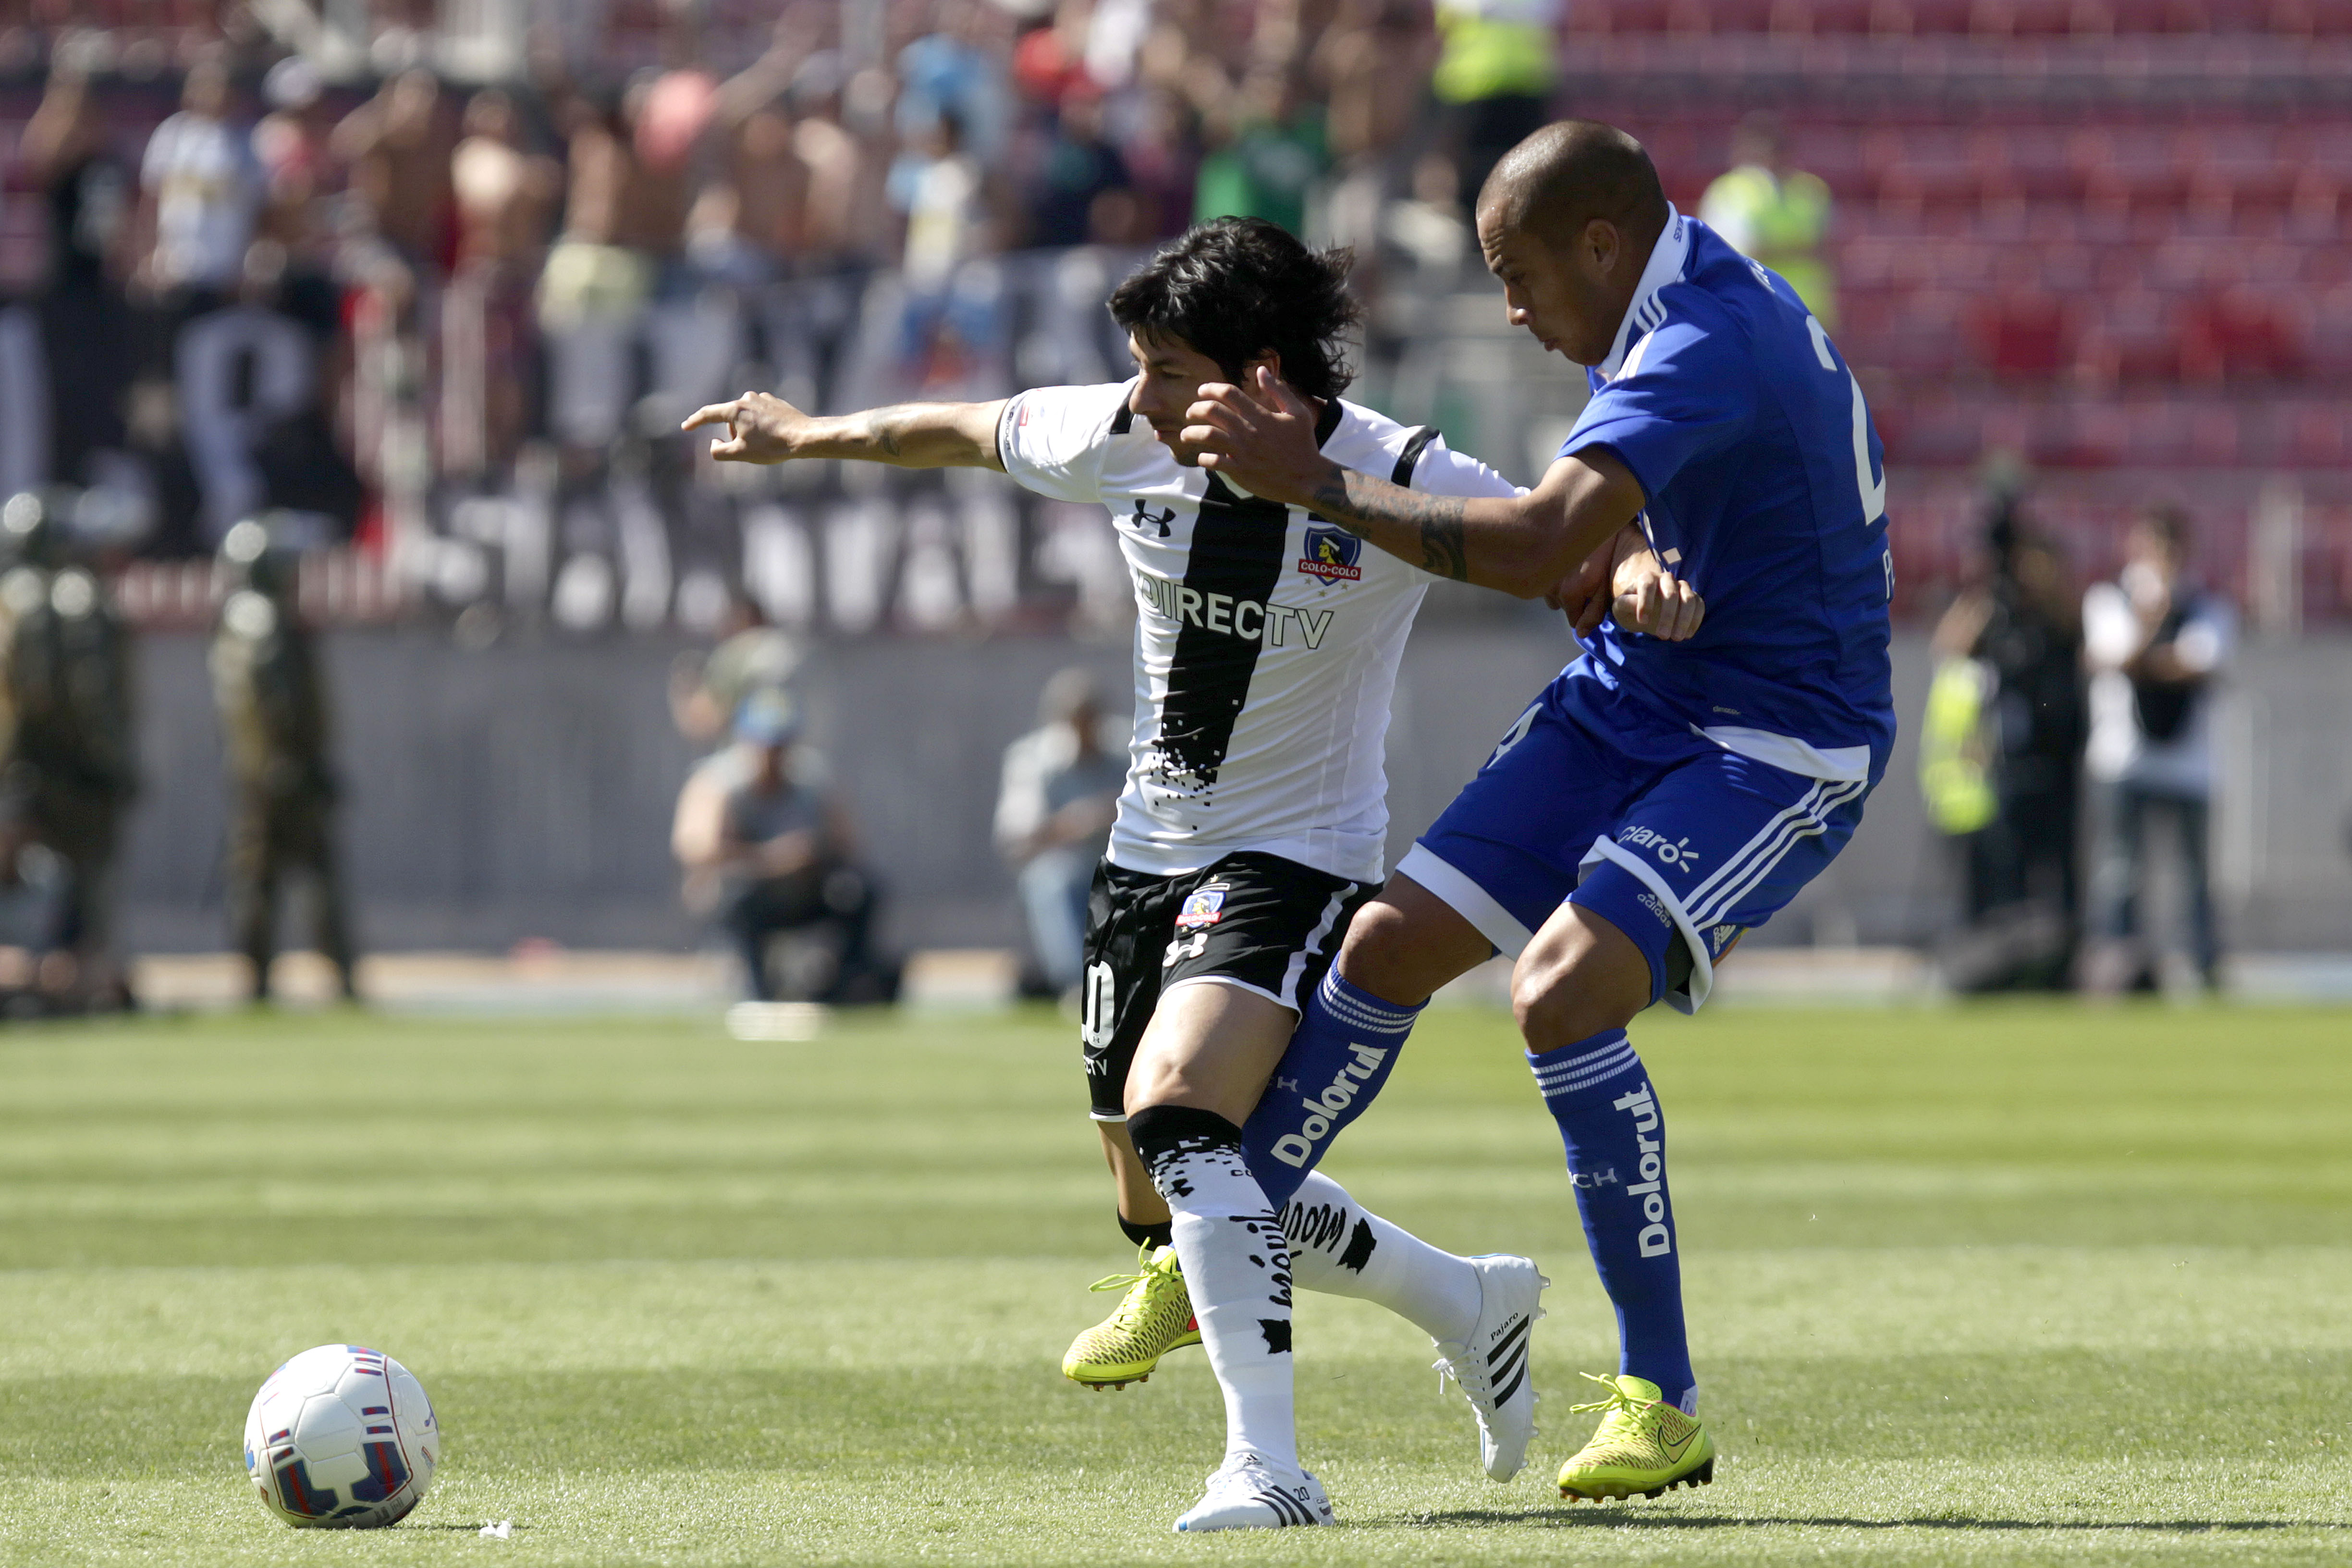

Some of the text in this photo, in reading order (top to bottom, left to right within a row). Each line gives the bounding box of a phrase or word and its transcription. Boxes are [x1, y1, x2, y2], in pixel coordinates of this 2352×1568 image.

[1300, 561, 1358, 577] COLO-COLO
[1137, 568, 1335, 650] DIRECTV
[1637, 894, 1672, 928] adidas
[1613, 1081, 1671, 1258] Dolorut
[1490, 1312, 1519, 1341] Pajaro
[1293, 1486, 1310, 1502] 20
